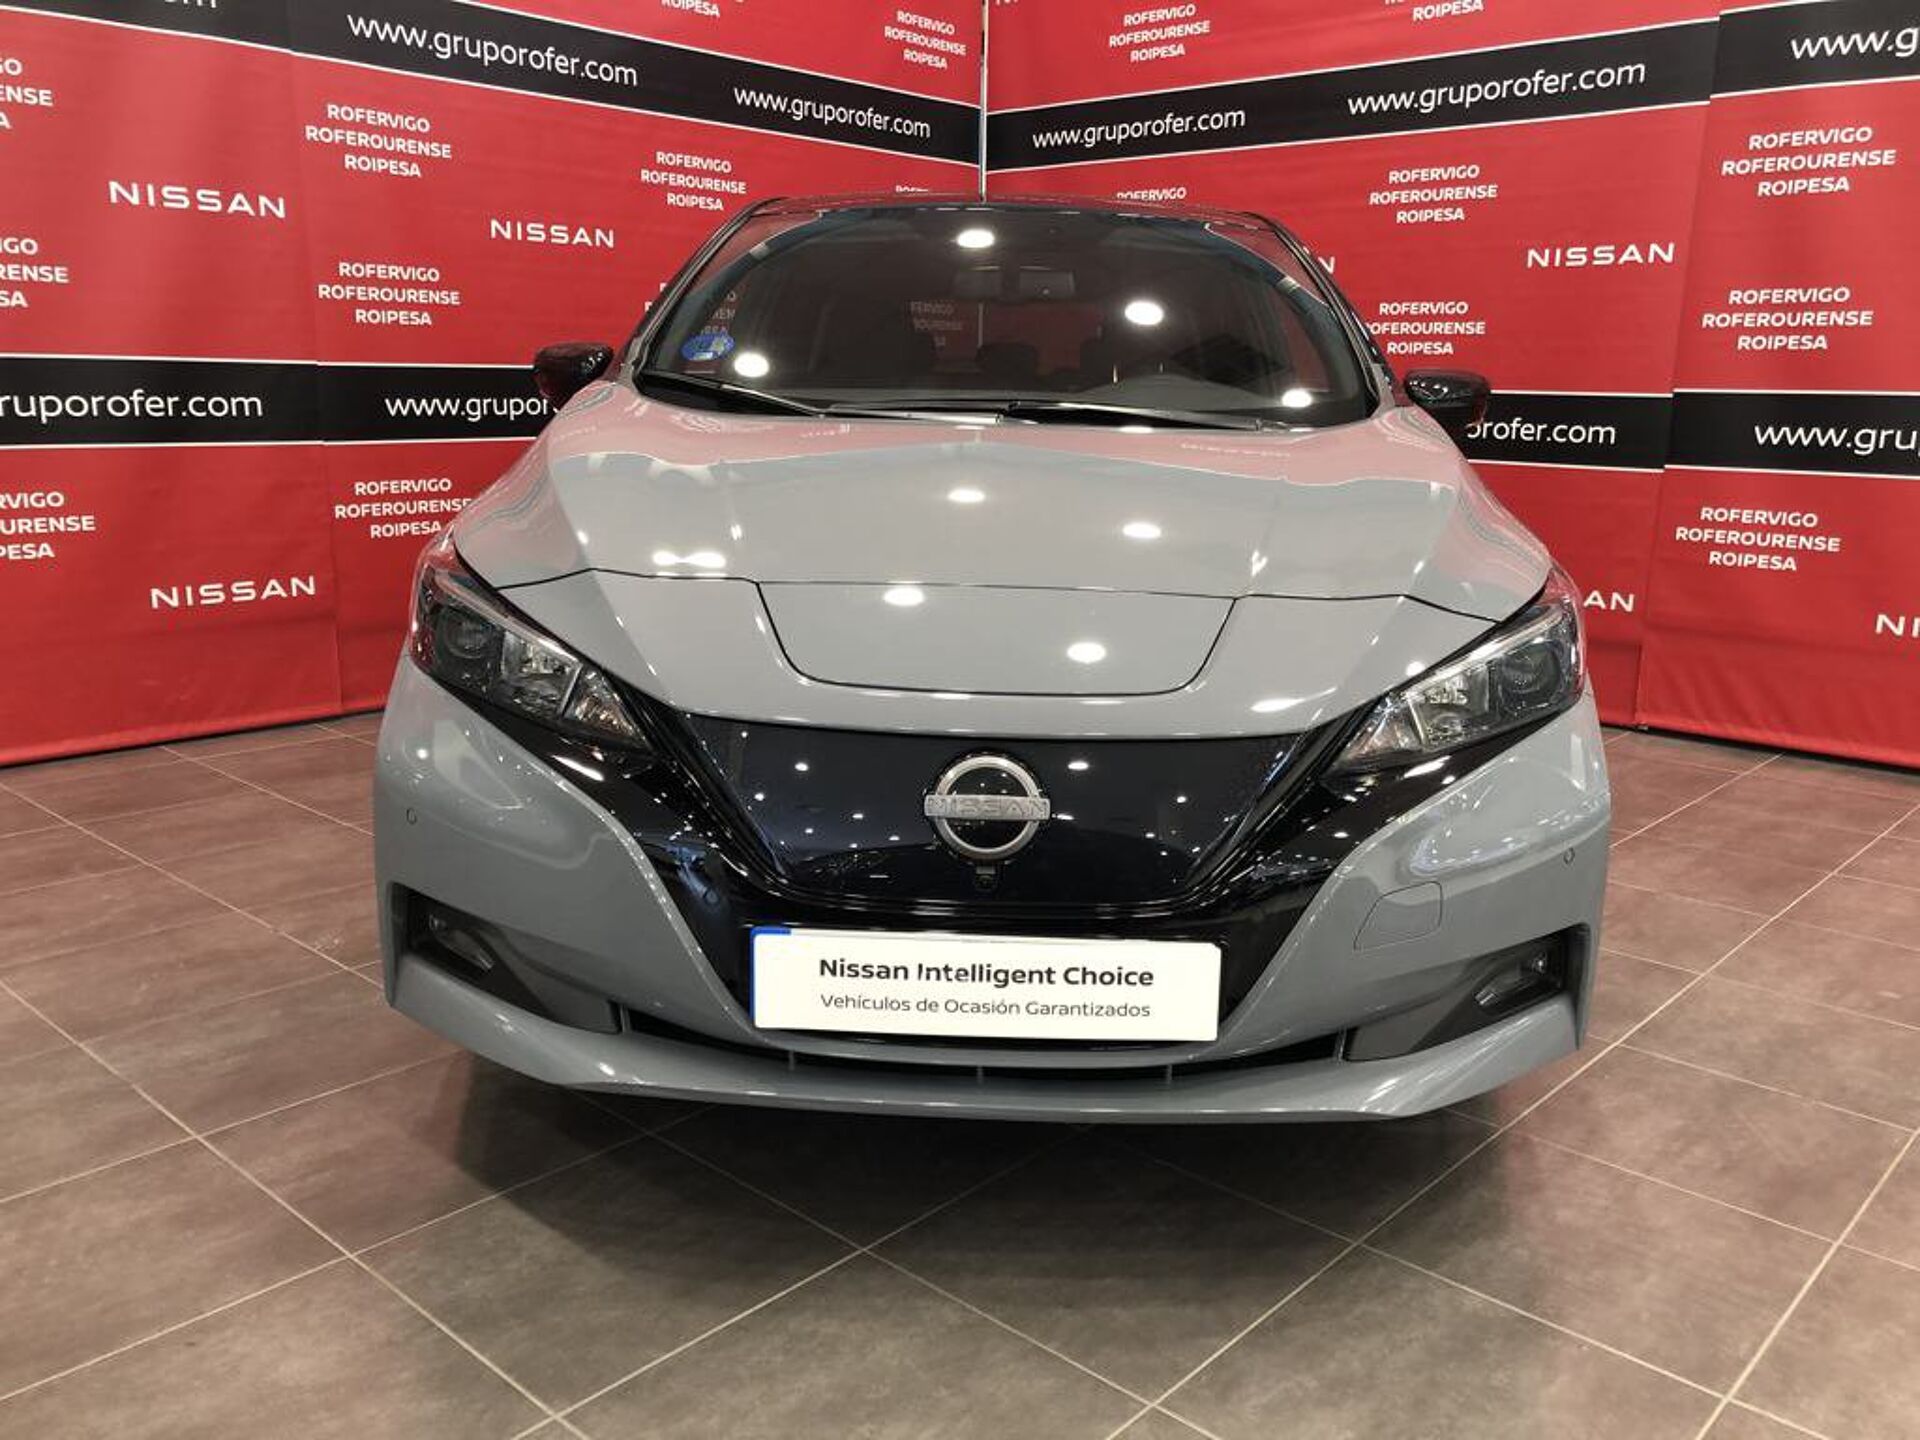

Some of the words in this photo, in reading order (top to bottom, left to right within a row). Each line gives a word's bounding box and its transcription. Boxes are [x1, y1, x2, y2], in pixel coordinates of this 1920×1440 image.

[1124, 4, 1196, 27] ROFERVIGO
[1413, 0, 1484, 21] ROIPESA
[896, 10, 956, 35] ROFERVIGO
[884, 25, 967, 56] ROFEROURENSE
[1109, 20, 1211, 48] ROFEROURENSE
[347, 14, 637, 86] www.gruporofer.com
[903, 48, 948, 70] ROIPESA
[1130, 43, 1185, 62] ROIPESA
[1348, 63, 1646, 115] www.gruporofer.com
[327, 103, 431, 133] ROFERVIGO
[733, 87, 932, 138] www.gruporofer.com
[1032, 109, 1246, 149] www.gruporofer.com
[1749, 126, 1873, 150] ROFERVIGO
[305, 124, 452, 159] ROFEROURENSE
[344, 153, 422, 178] ROIPESA
[655, 151, 732, 173] ROFERVIGO
[1721, 149, 1897, 176] ROFEROURENSE
[640, 169, 747, 194] ROFEROURENSE
[1388, 164, 1480, 184] ROFERVIGO
[1369, 184, 1498, 205] ROFEROURENSE
[1758, 175, 1850, 197] ROIPESA
[108, 180, 286, 219] NISSAN
[666, 191, 725, 211] ROIPESA
[1396, 207, 1465, 223] ROIPESA
[490, 219, 614, 248] NISSAN
[1527, 243, 1675, 267] NISSAN
[338, 262, 440, 282] ROFERVIGO
[318, 284, 460, 305] ROFEROURENSE
[1729, 287, 1850, 305] ROFERVIGO
[355, 308, 432, 325] ROIPESA
[1379, 301, 1468, 315] ROFERVIGO
[1702, 310, 1873, 328] ROFEROURENSE
[1367, 321, 1486, 336] OFEROURENSE
[1387, 341, 1454, 355] ROIPESA
[1737, 334, 1827, 350] ROIPESA
[1754, 425, 1920, 456] www.gru
[354, 477, 452, 496] ROFERVIGO
[1700, 507, 1818, 528] ROFERVIGO
[370, 520, 442, 538] ROIPESA
[1675, 526, 1841, 552] ROFEROURENSE
[1709, 551, 1797, 571] ROIPESA
[150, 575, 317, 609] NISSAN
[928, 797, 1047, 819] NISSAN
[820, 958, 909, 981] Nissan
[917, 963, 1057, 989] Intelligent
[1063, 966, 1154, 986] Choice
[820, 994, 910, 1012] Vehículos
[915, 999, 940, 1013] de
[944, 999, 1021, 1015] Ocasión
[1024, 1001, 1151, 1017] Garantizados
